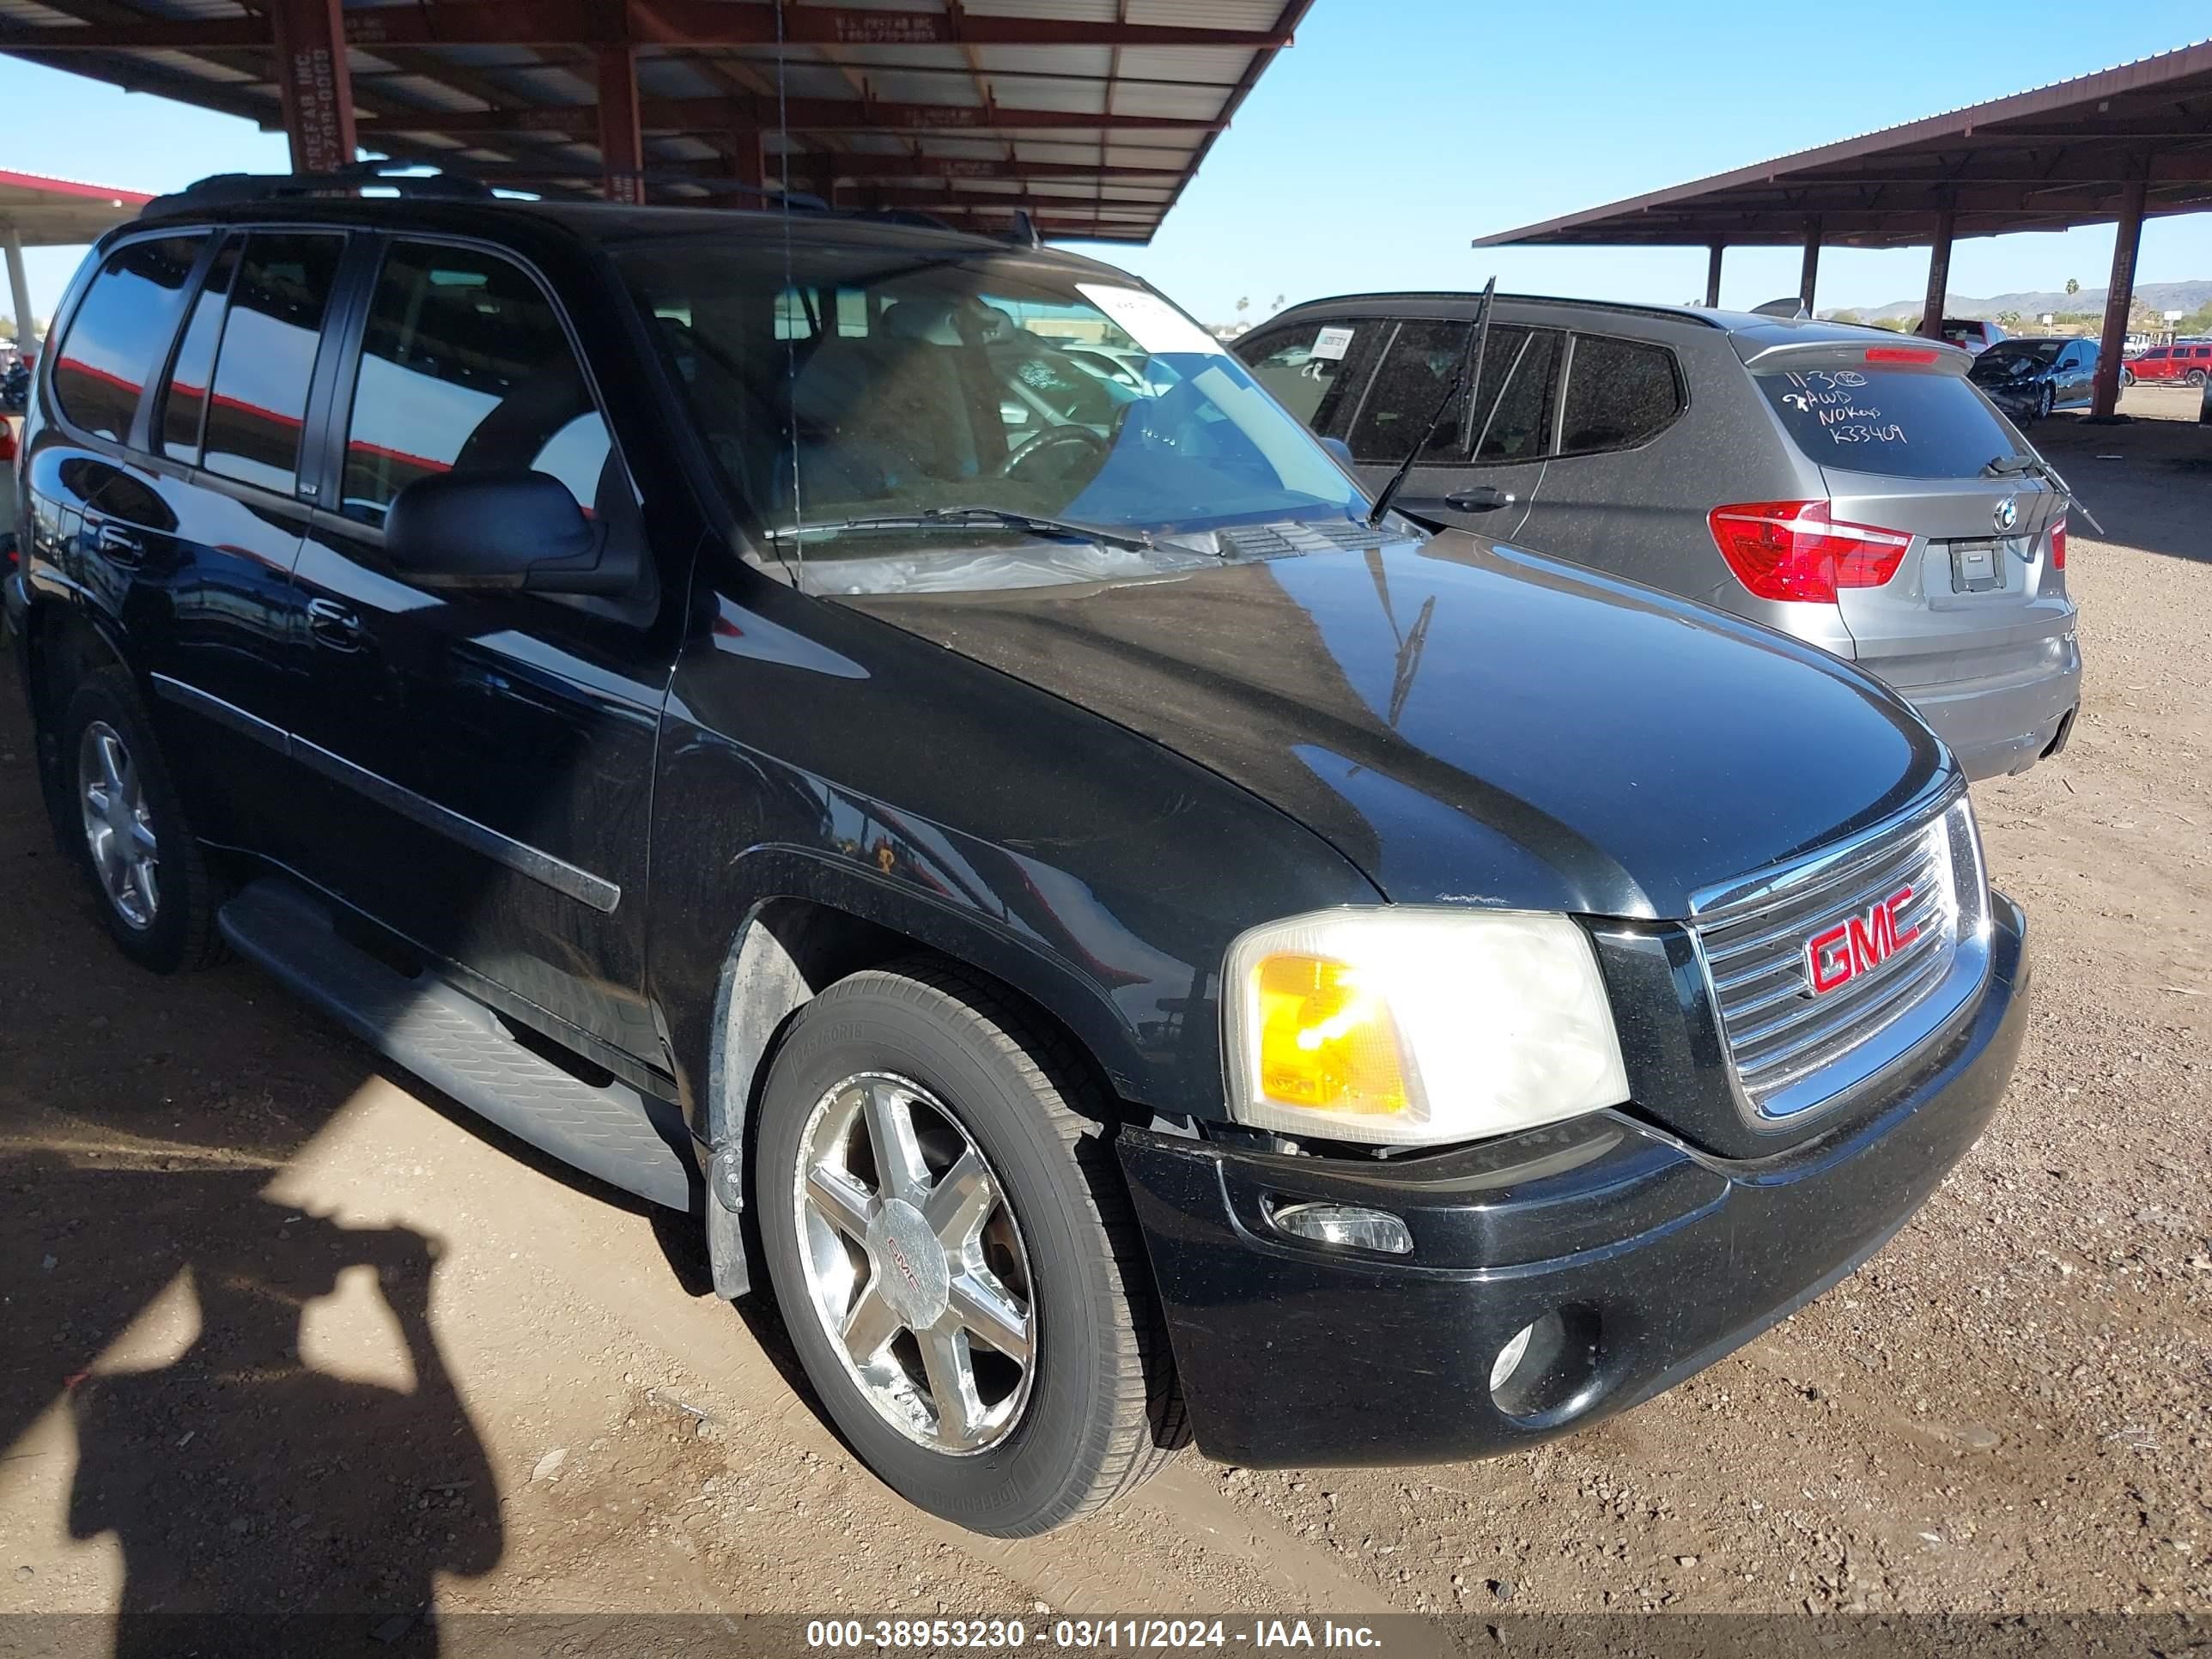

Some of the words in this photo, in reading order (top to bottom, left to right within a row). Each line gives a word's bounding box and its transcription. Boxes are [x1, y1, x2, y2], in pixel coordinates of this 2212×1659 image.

[1829, 424, 1907, 445] K33409
[1802, 883, 1920, 994] GMC
[887, 1237, 921, 1293] GMC
